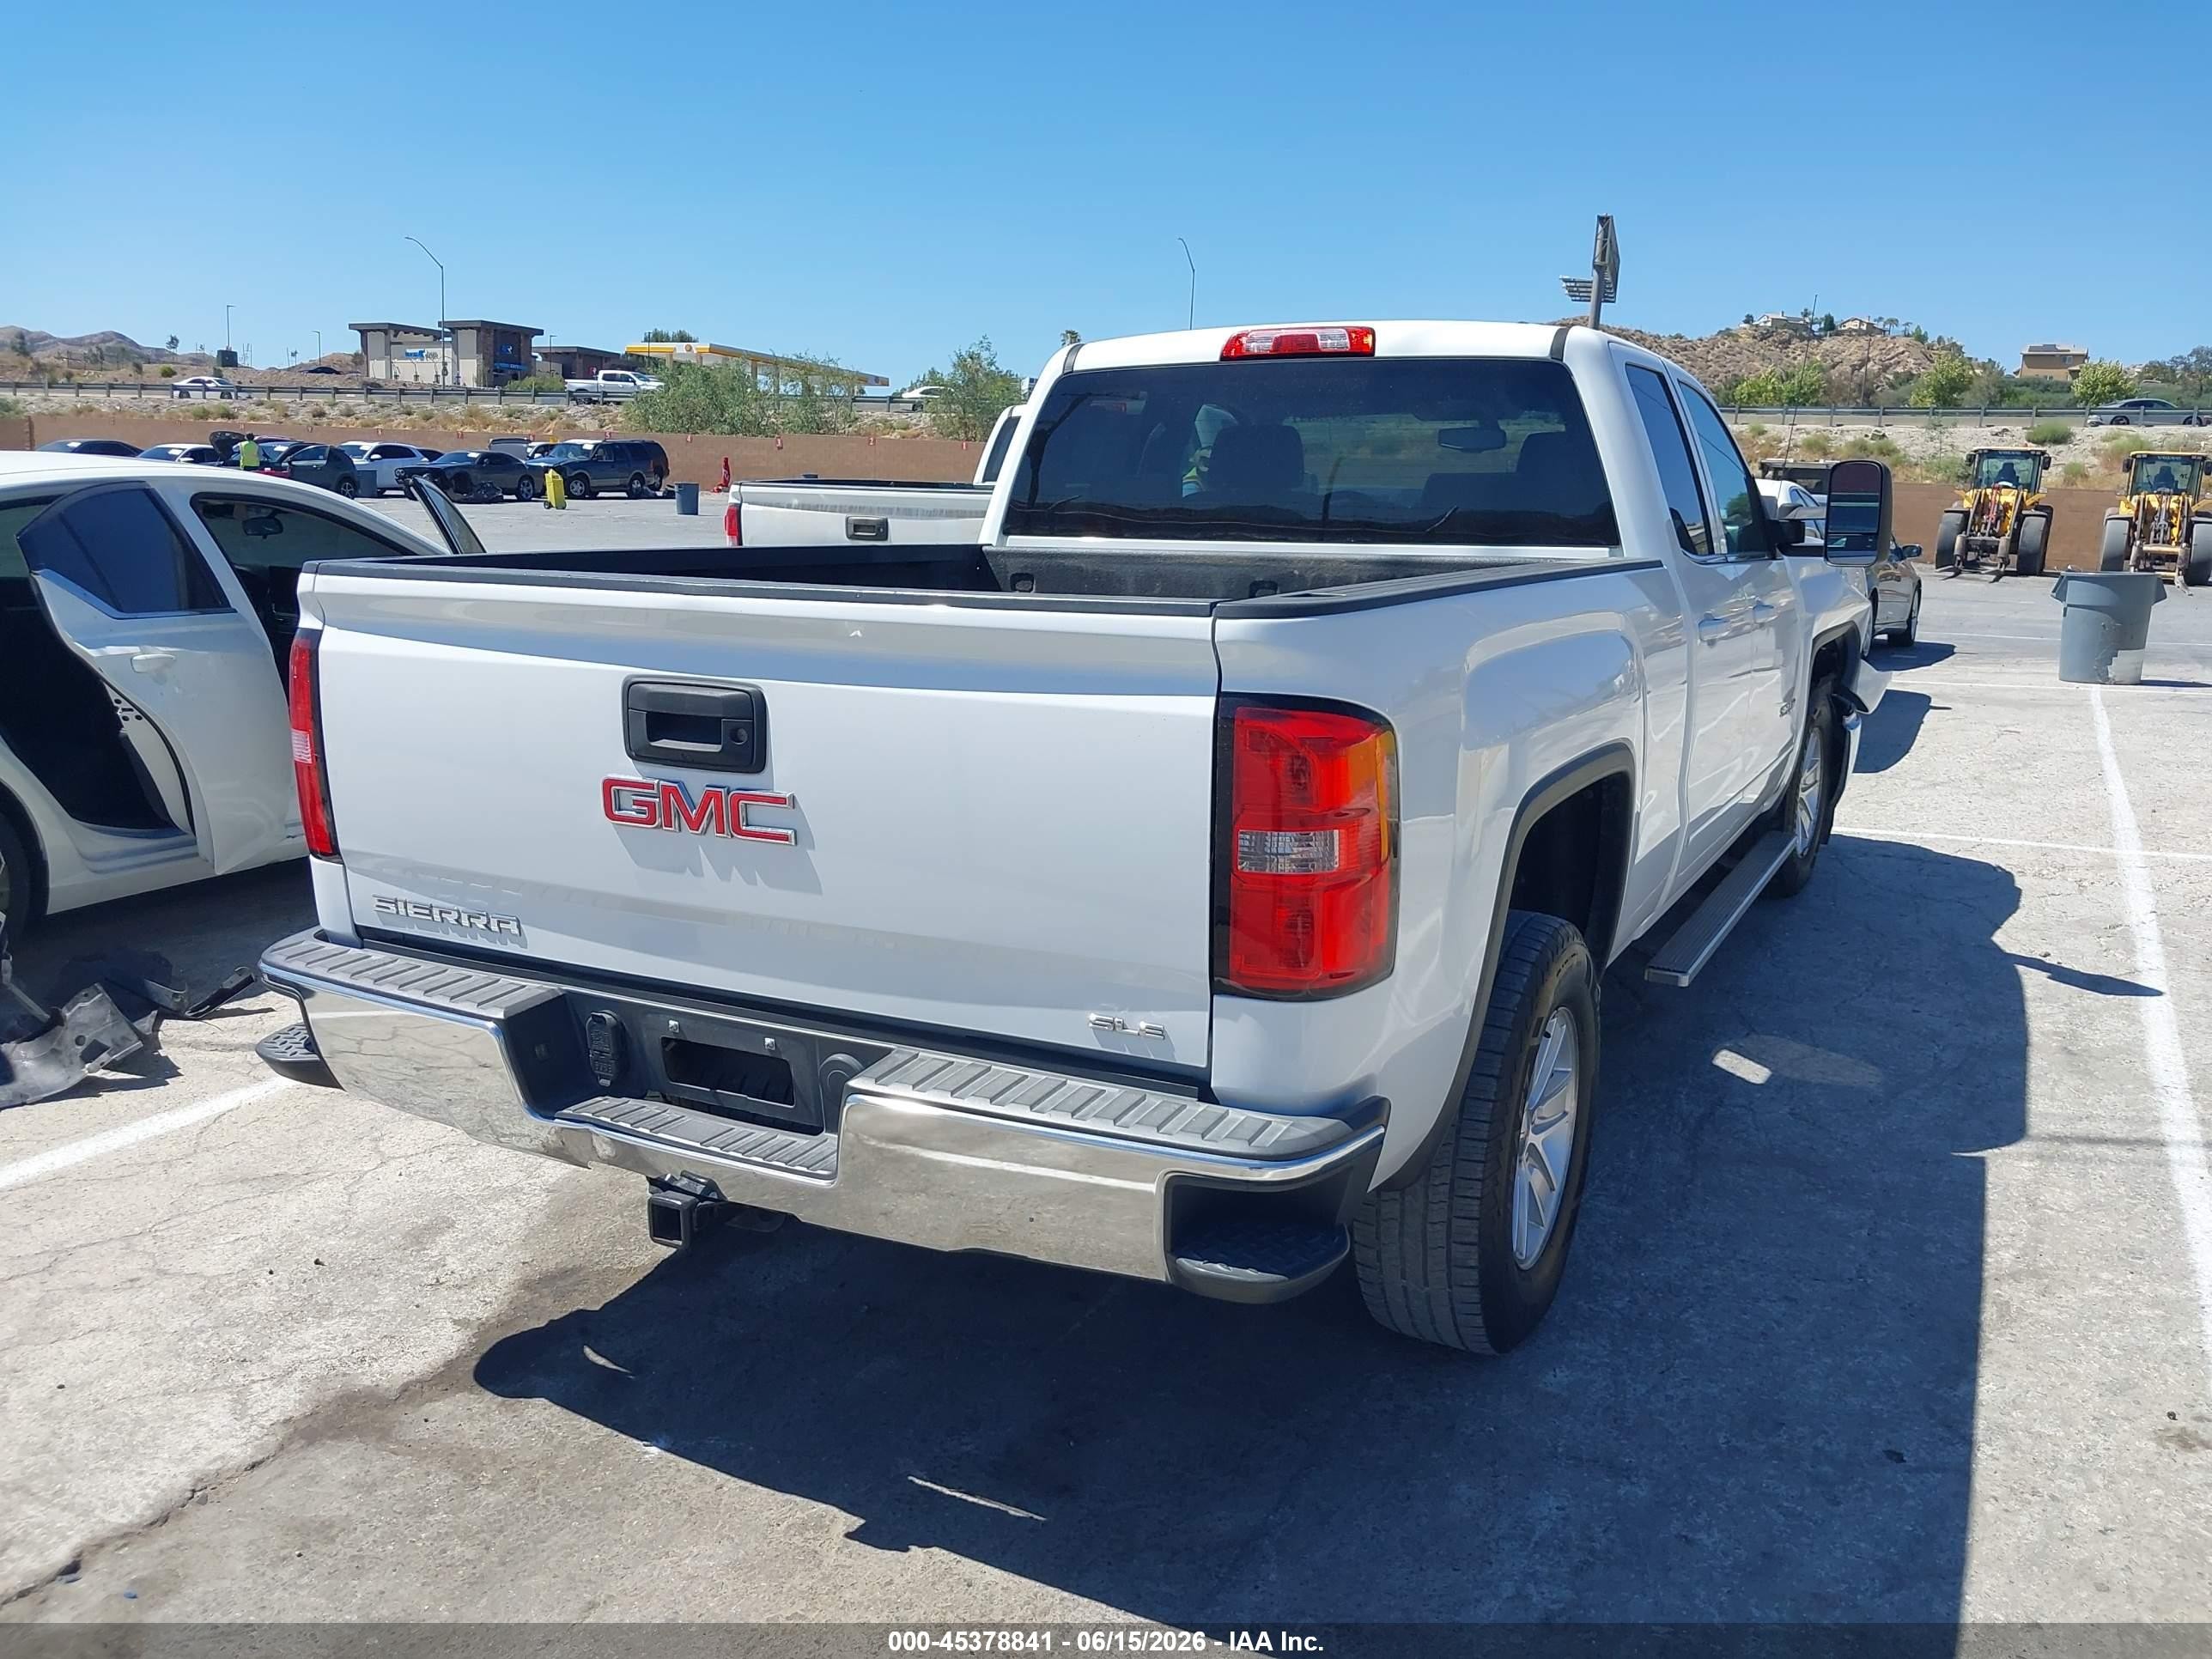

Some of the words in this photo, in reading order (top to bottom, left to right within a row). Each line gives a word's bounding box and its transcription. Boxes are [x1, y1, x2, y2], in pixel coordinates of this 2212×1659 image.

[600, 773, 798, 846] GMC
[372, 894, 521, 937] SIERRA
[1087, 1012, 1165, 1040] SLE
